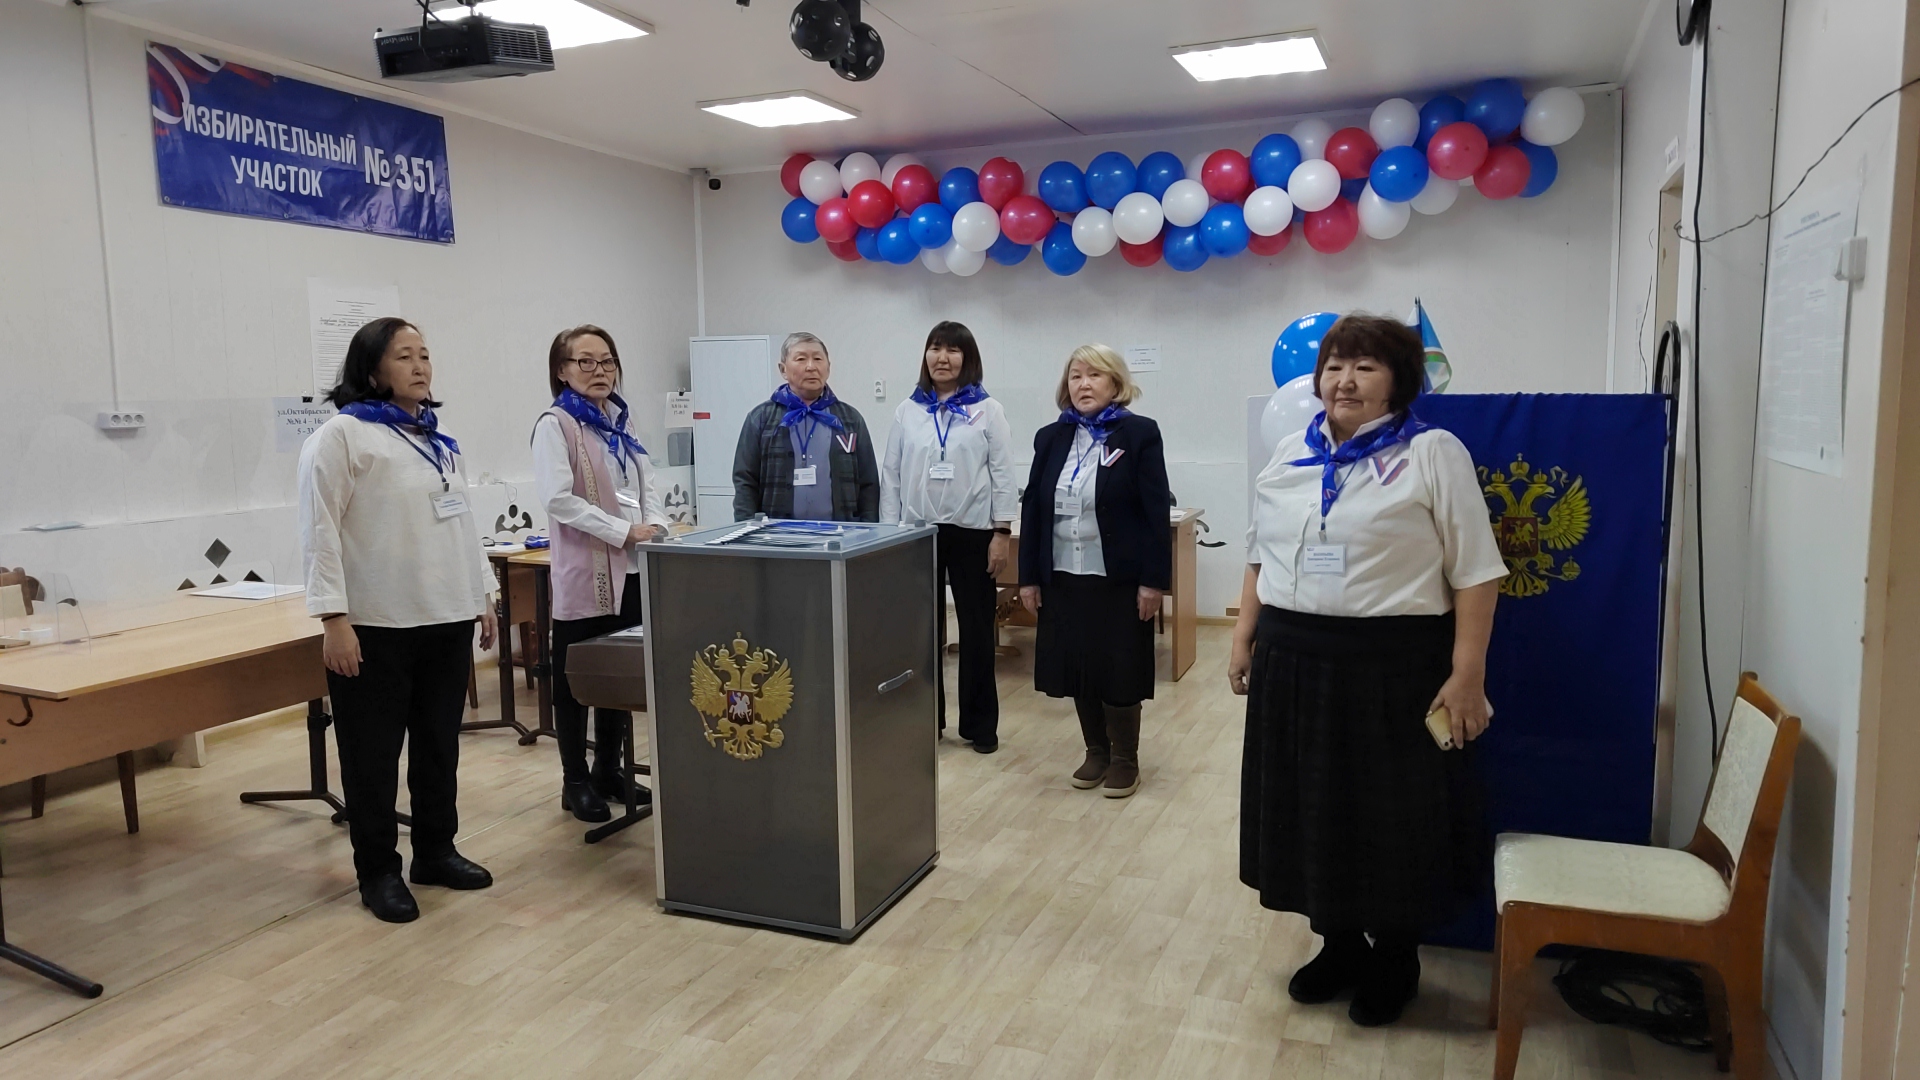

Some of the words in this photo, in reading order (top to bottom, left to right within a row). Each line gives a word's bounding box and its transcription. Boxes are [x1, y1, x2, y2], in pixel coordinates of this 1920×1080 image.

[182, 101, 357, 166] ИЗБИРАТЕЛЬНЫЙ
[230, 155, 323, 197] УЧАСТОК
[396, 153, 436, 195] 351
